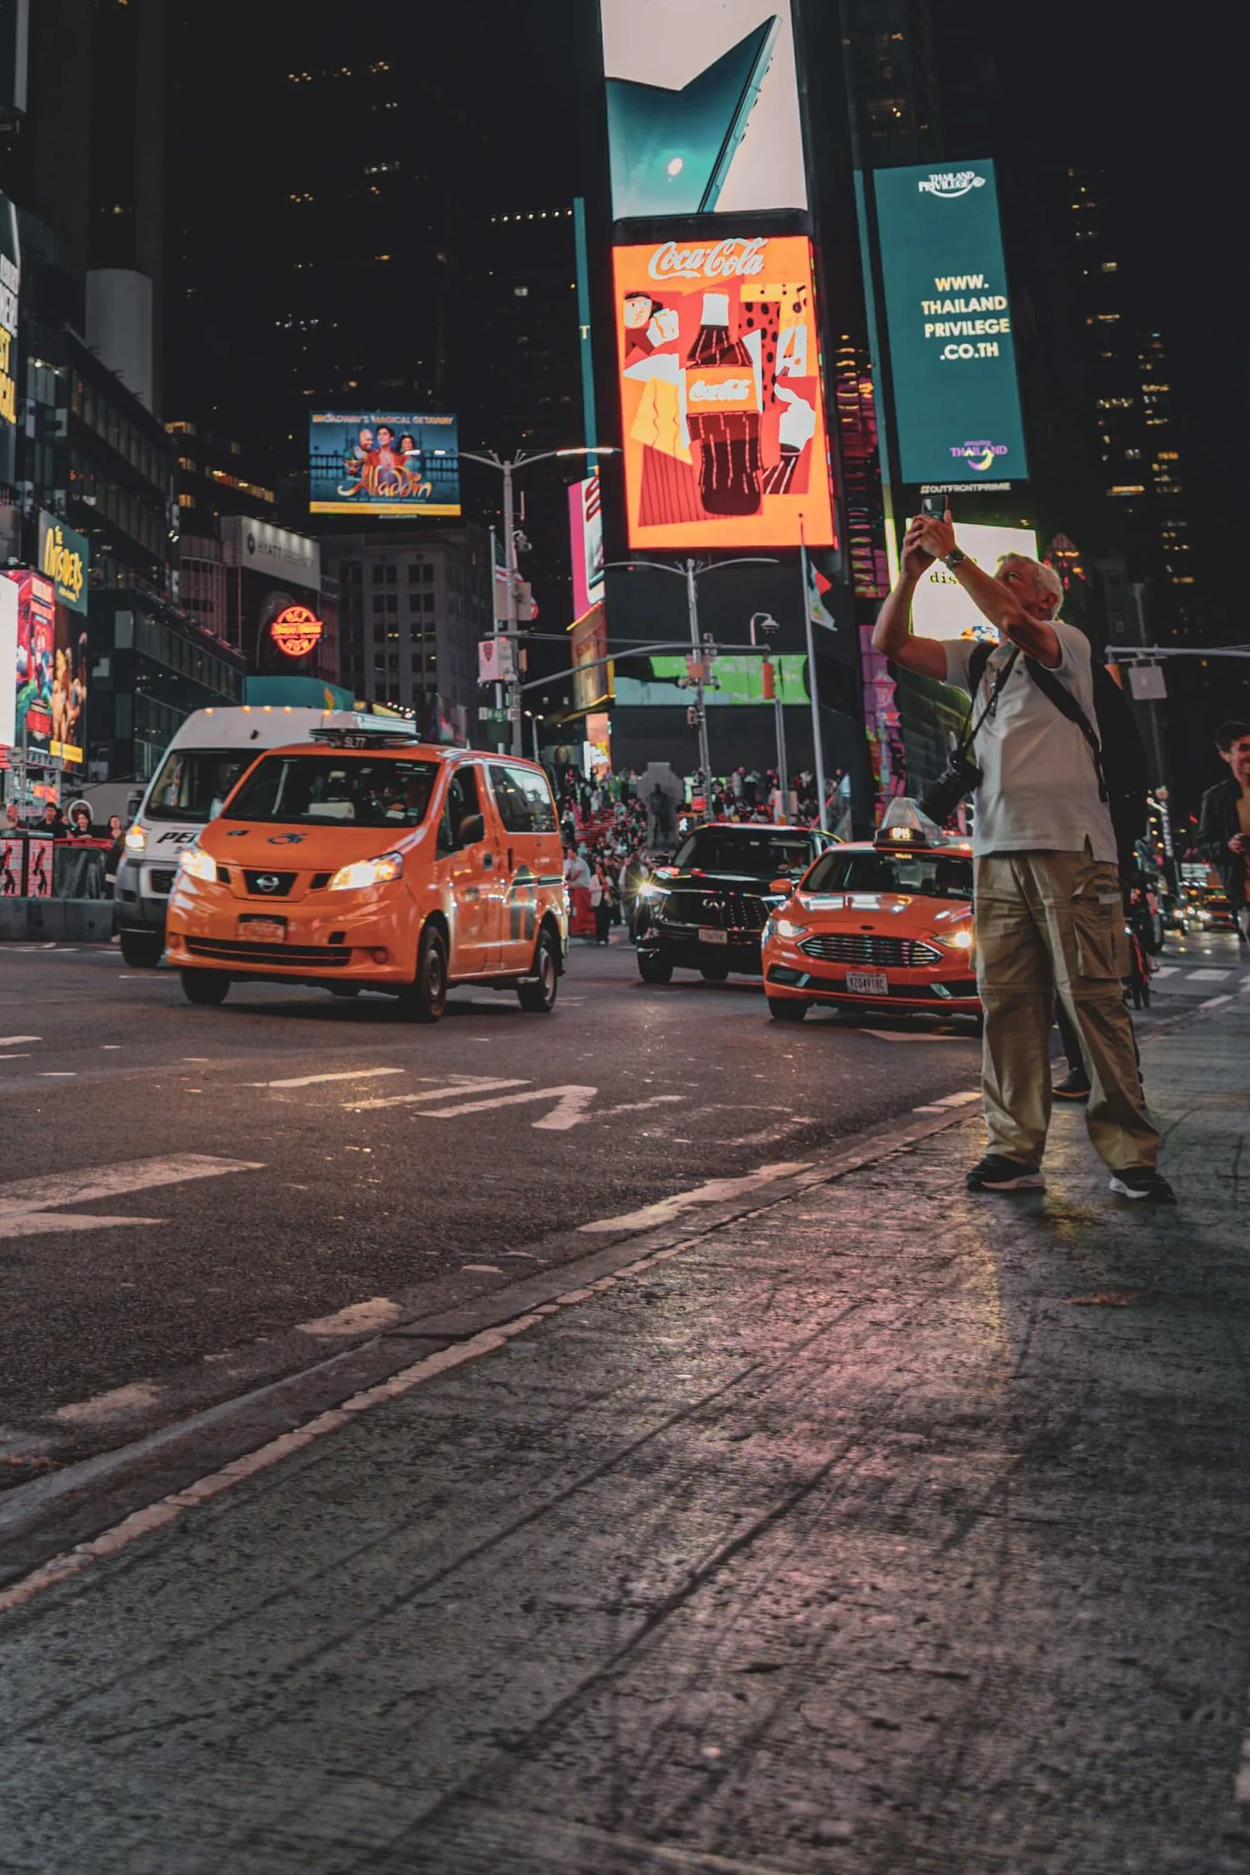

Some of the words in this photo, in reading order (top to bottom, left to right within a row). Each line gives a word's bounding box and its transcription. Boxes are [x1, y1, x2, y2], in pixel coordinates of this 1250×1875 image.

[918, 179, 972, 193] PRIVILEGE
[648, 237, 768, 280] Coca-Cola
[935, 274, 990, 292] WWW.
[921, 295, 1007, 315] THAILAND
[924, 318, 1011, 338] PRIVILEGE
[940, 342, 999, 360] .CO.TH
[312, 413, 370, 424] BROADWAY'S
[371, 415, 412, 425] MAGICAL
[413, 416, 454, 425] GETAWAY
[950, 444, 1008, 458] THAILAND
[337, 464, 433, 498] Aladdin
[929, 571, 958, 585] dis
